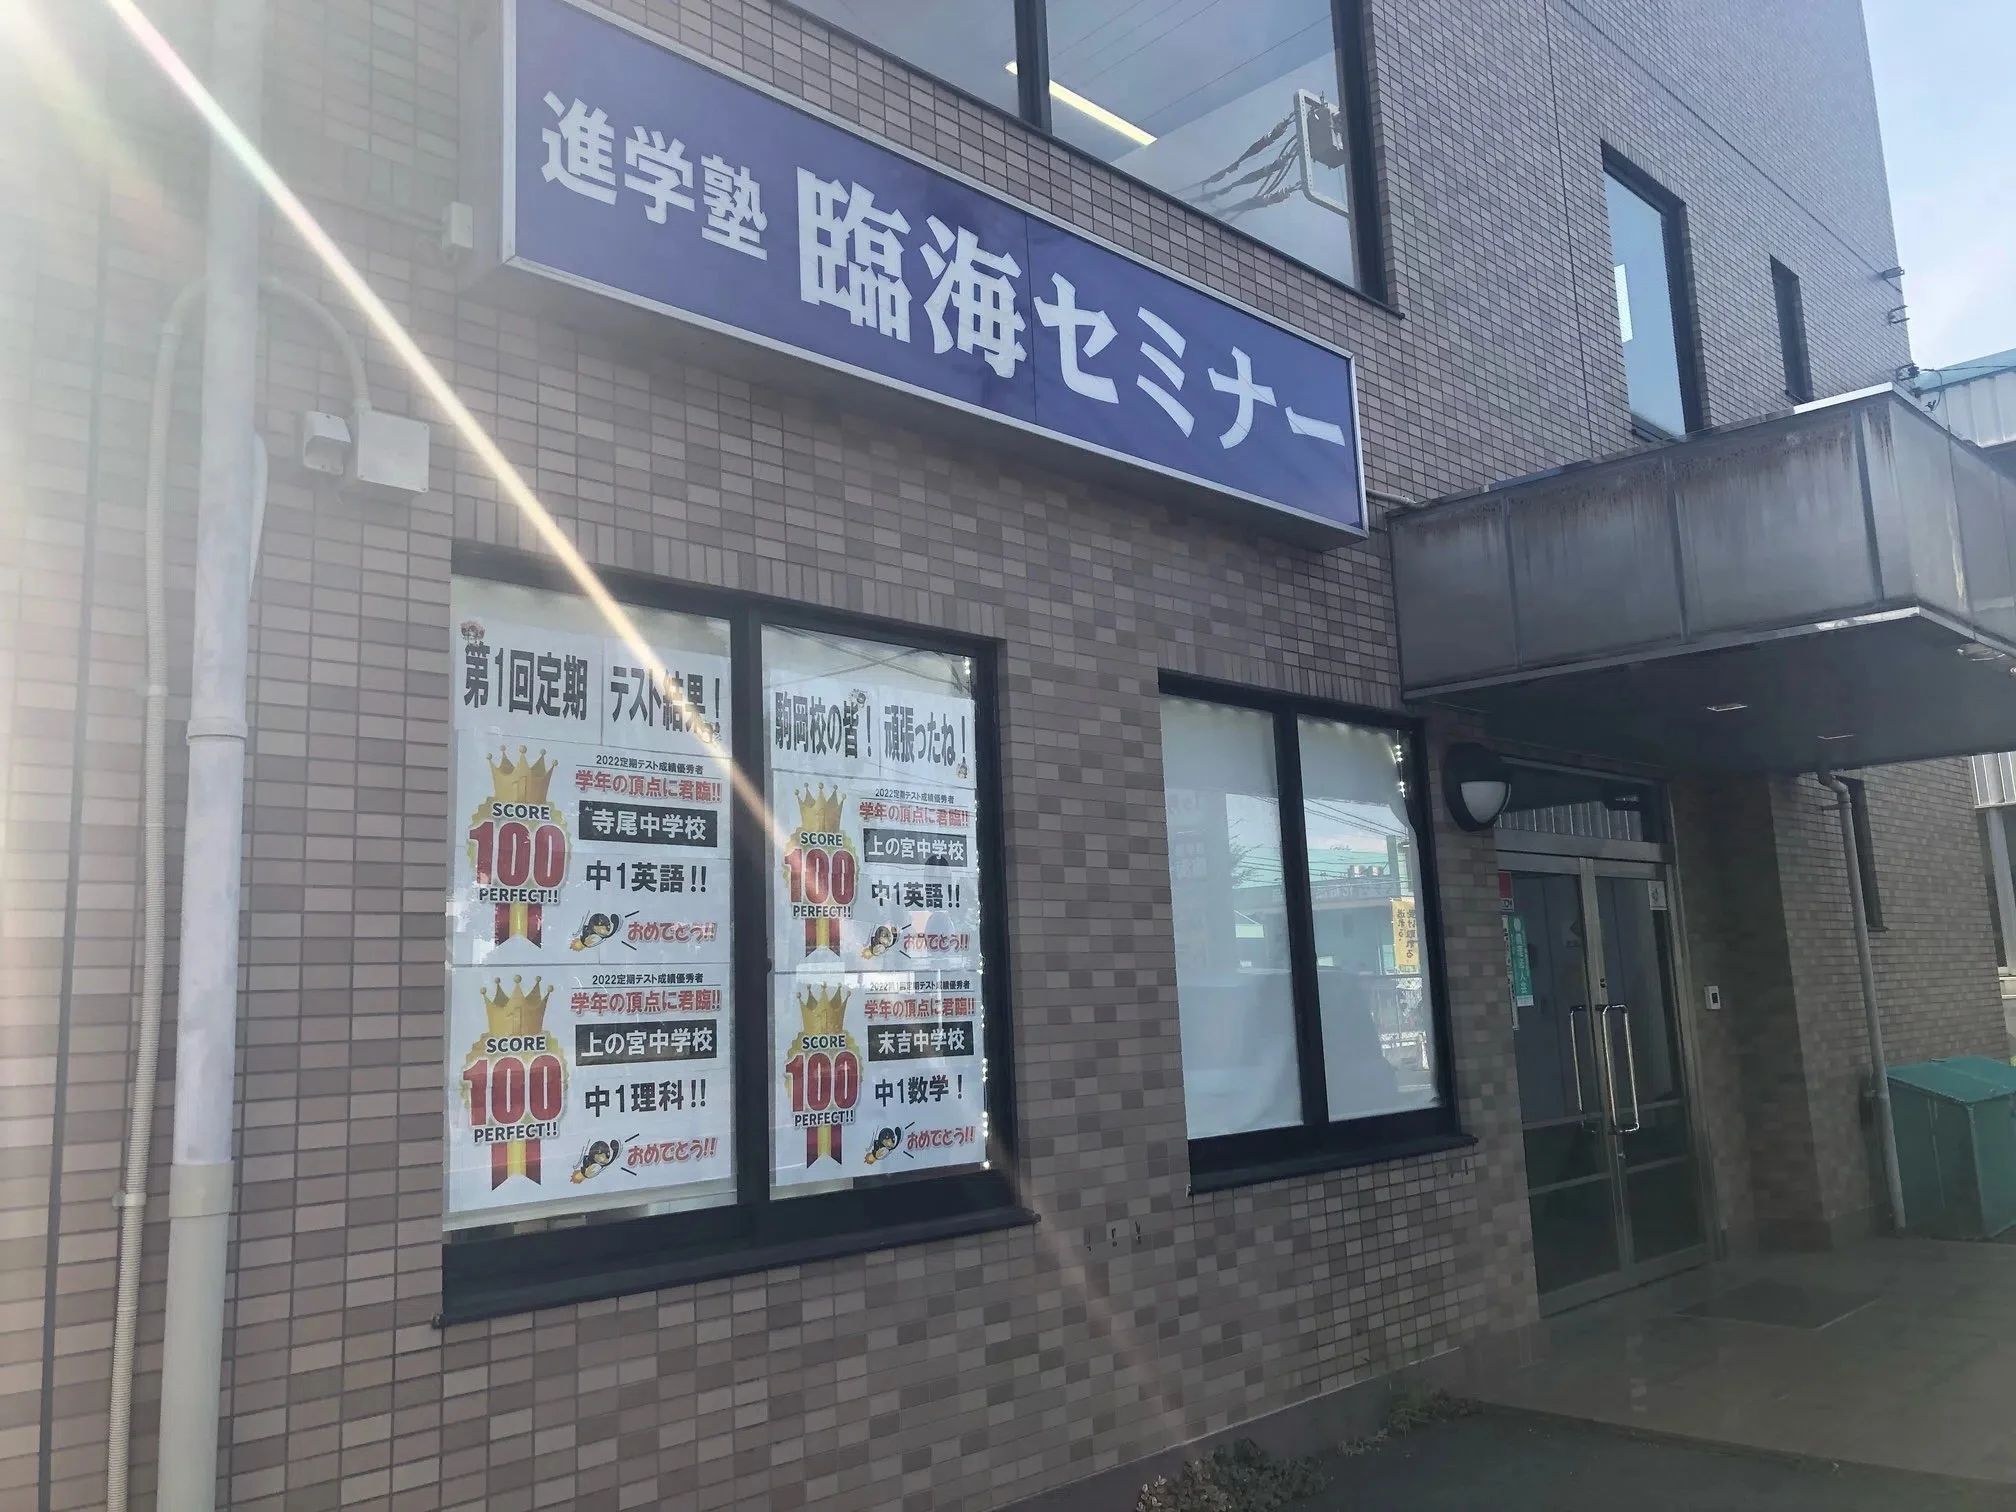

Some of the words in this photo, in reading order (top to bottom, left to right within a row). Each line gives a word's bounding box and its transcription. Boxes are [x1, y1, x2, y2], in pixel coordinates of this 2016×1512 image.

[542, 90, 768, 261] 進学塾
[796, 167, 1345, 450] 臨海セミナー
[464, 642, 587, 720] 第1回定期
[596, 755, 703, 777] 2022定期テスト成績優秀者
[575, 770, 722, 802] 学年の頂点に君臨!!
[492, 803, 550, 820] SCORE
[592, 808, 707, 841] 寺尾中学校
[859, 801, 969, 827] 学年の頂点に君臨!!
[800, 832, 842, 846] SCORE
[868, 835, 964, 861] 上の宮中学校
[469, 822, 566, 888] 100
[586, 860, 707, 893] 中1英語!!
[784, 848, 856, 904] 100
[479, 888, 558, 903] PERFECT!!
[871, 880, 960, 908] 中1英語!!
[793, 905, 851, 918] PERFECT!!
[628, 922, 718, 943] おめでとう!!
[903, 932, 969, 951] おめでとう!!
[592, 973, 704, 985] 2022定期テスト成績優秀者
[571, 989, 721, 1015] 学年の頂点に君臨!!
[864, 997, 975, 1020] 学年の頂点に君臨!!
[486, 1036, 546, 1053] SCORE
[581, 1027, 713, 1058] 上の宮中学校
[802, 1035, 846, 1049] SCORE
[878, 1028, 965, 1055] 末吉中学校
[463, 1055, 562, 1126] 100
[786, 1051, 858, 1112] 100
[875, 1074, 962, 1108] 中1数学!
[585, 1079, 706, 1118] 中1理科!!
[795, 1110, 854, 1127] PERFECT!!
[474, 1122, 558, 1143] PERFECT!!
[907, 1127, 975, 1150] おめでとう!!
[627, 1137, 718, 1167] おめでとう!!
